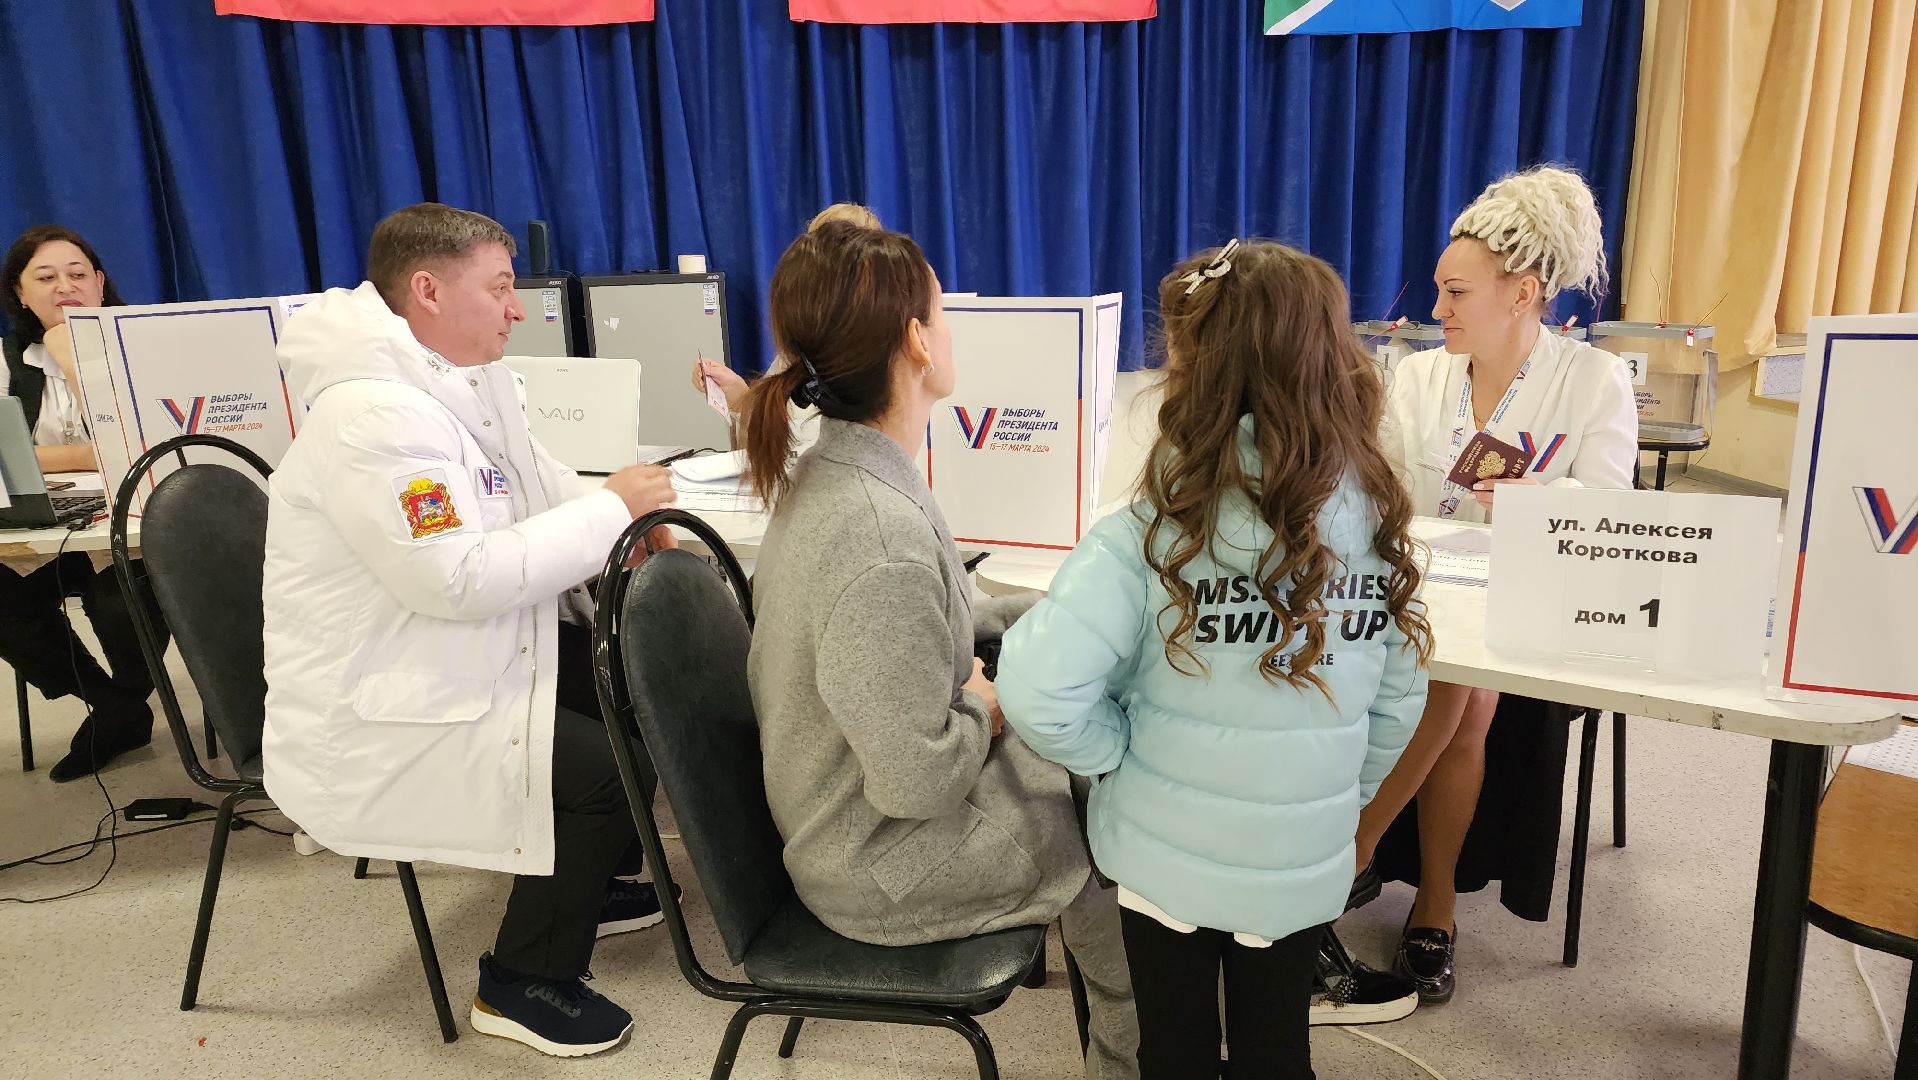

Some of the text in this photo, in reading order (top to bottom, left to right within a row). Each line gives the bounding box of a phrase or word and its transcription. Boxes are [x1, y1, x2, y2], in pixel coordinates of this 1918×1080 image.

[1626, 359, 1638, 379] 3
[210, 392, 253, 404] ВЫБОРЫ
[208, 402, 268, 414] ПРЕЗИДЕНТА
[1001, 407, 1046, 418] ВЫБОРЫ
[205, 413, 244, 425] РОССИИ
[538, 407, 585, 422] VAIO
[222, 423, 246, 433] МАРТА
[246, 422, 263, 431] 2024
[997, 419, 1059, 431] ПРЕЗИДЕНТА
[992, 431, 1032, 442] РОССИИ
[1009, 443, 1032, 452] МАРТА
[1032, 444, 1050, 453] 2024
[1547, 517, 1713, 540] ул. Алексея
[1557, 539, 1699, 564] Короткова
[1195, 574, 1391, 605] MS.RIES
[1574, 598, 1661, 628] дом 1
[1195, 609, 1389, 644] SWI UP
